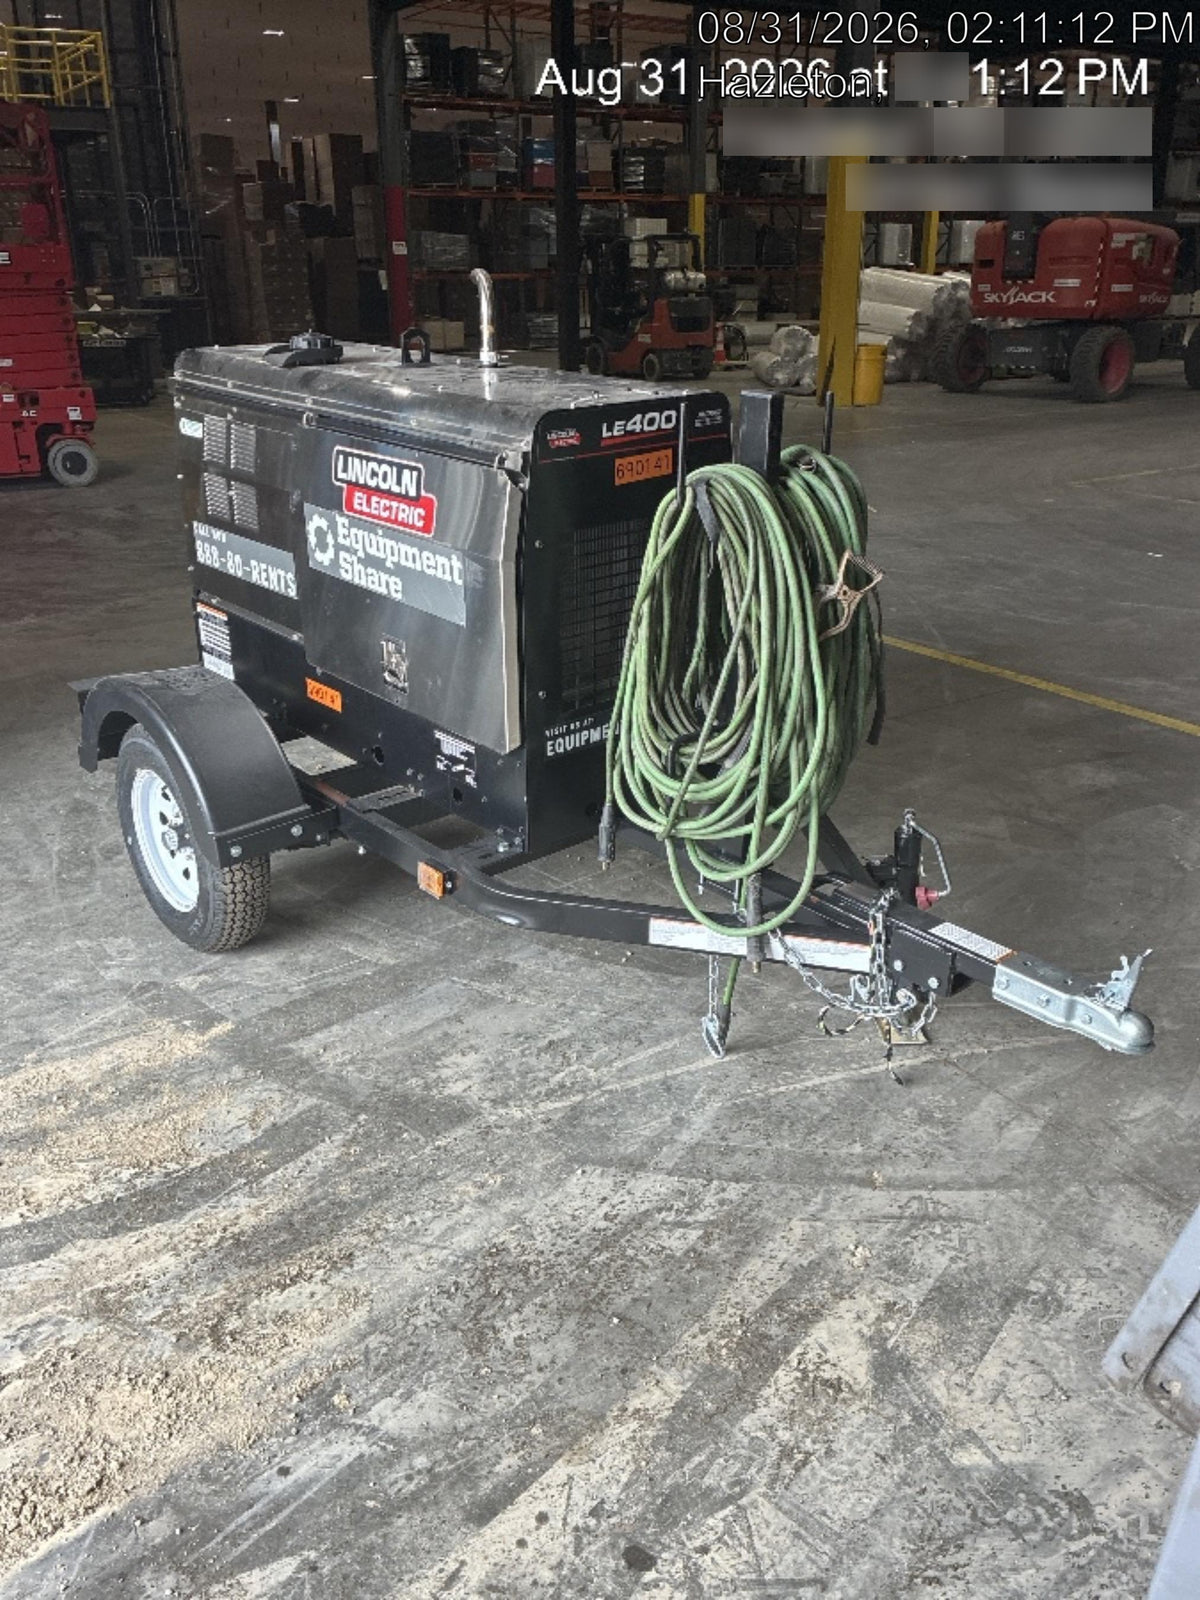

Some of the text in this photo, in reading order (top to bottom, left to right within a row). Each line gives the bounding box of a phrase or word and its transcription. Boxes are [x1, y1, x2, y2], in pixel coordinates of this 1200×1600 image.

[984, 286, 1056, 304] SKYJACK
[602, 410, 677, 438] LE400
[336, 454, 419, 497] LINCOLN
[352, 491, 426, 528] ELECTRIC
[195, 540, 298, 598] 888-80-RENTS
[335, 514, 464, 586] Equipment
[338, 552, 404, 599] Share
